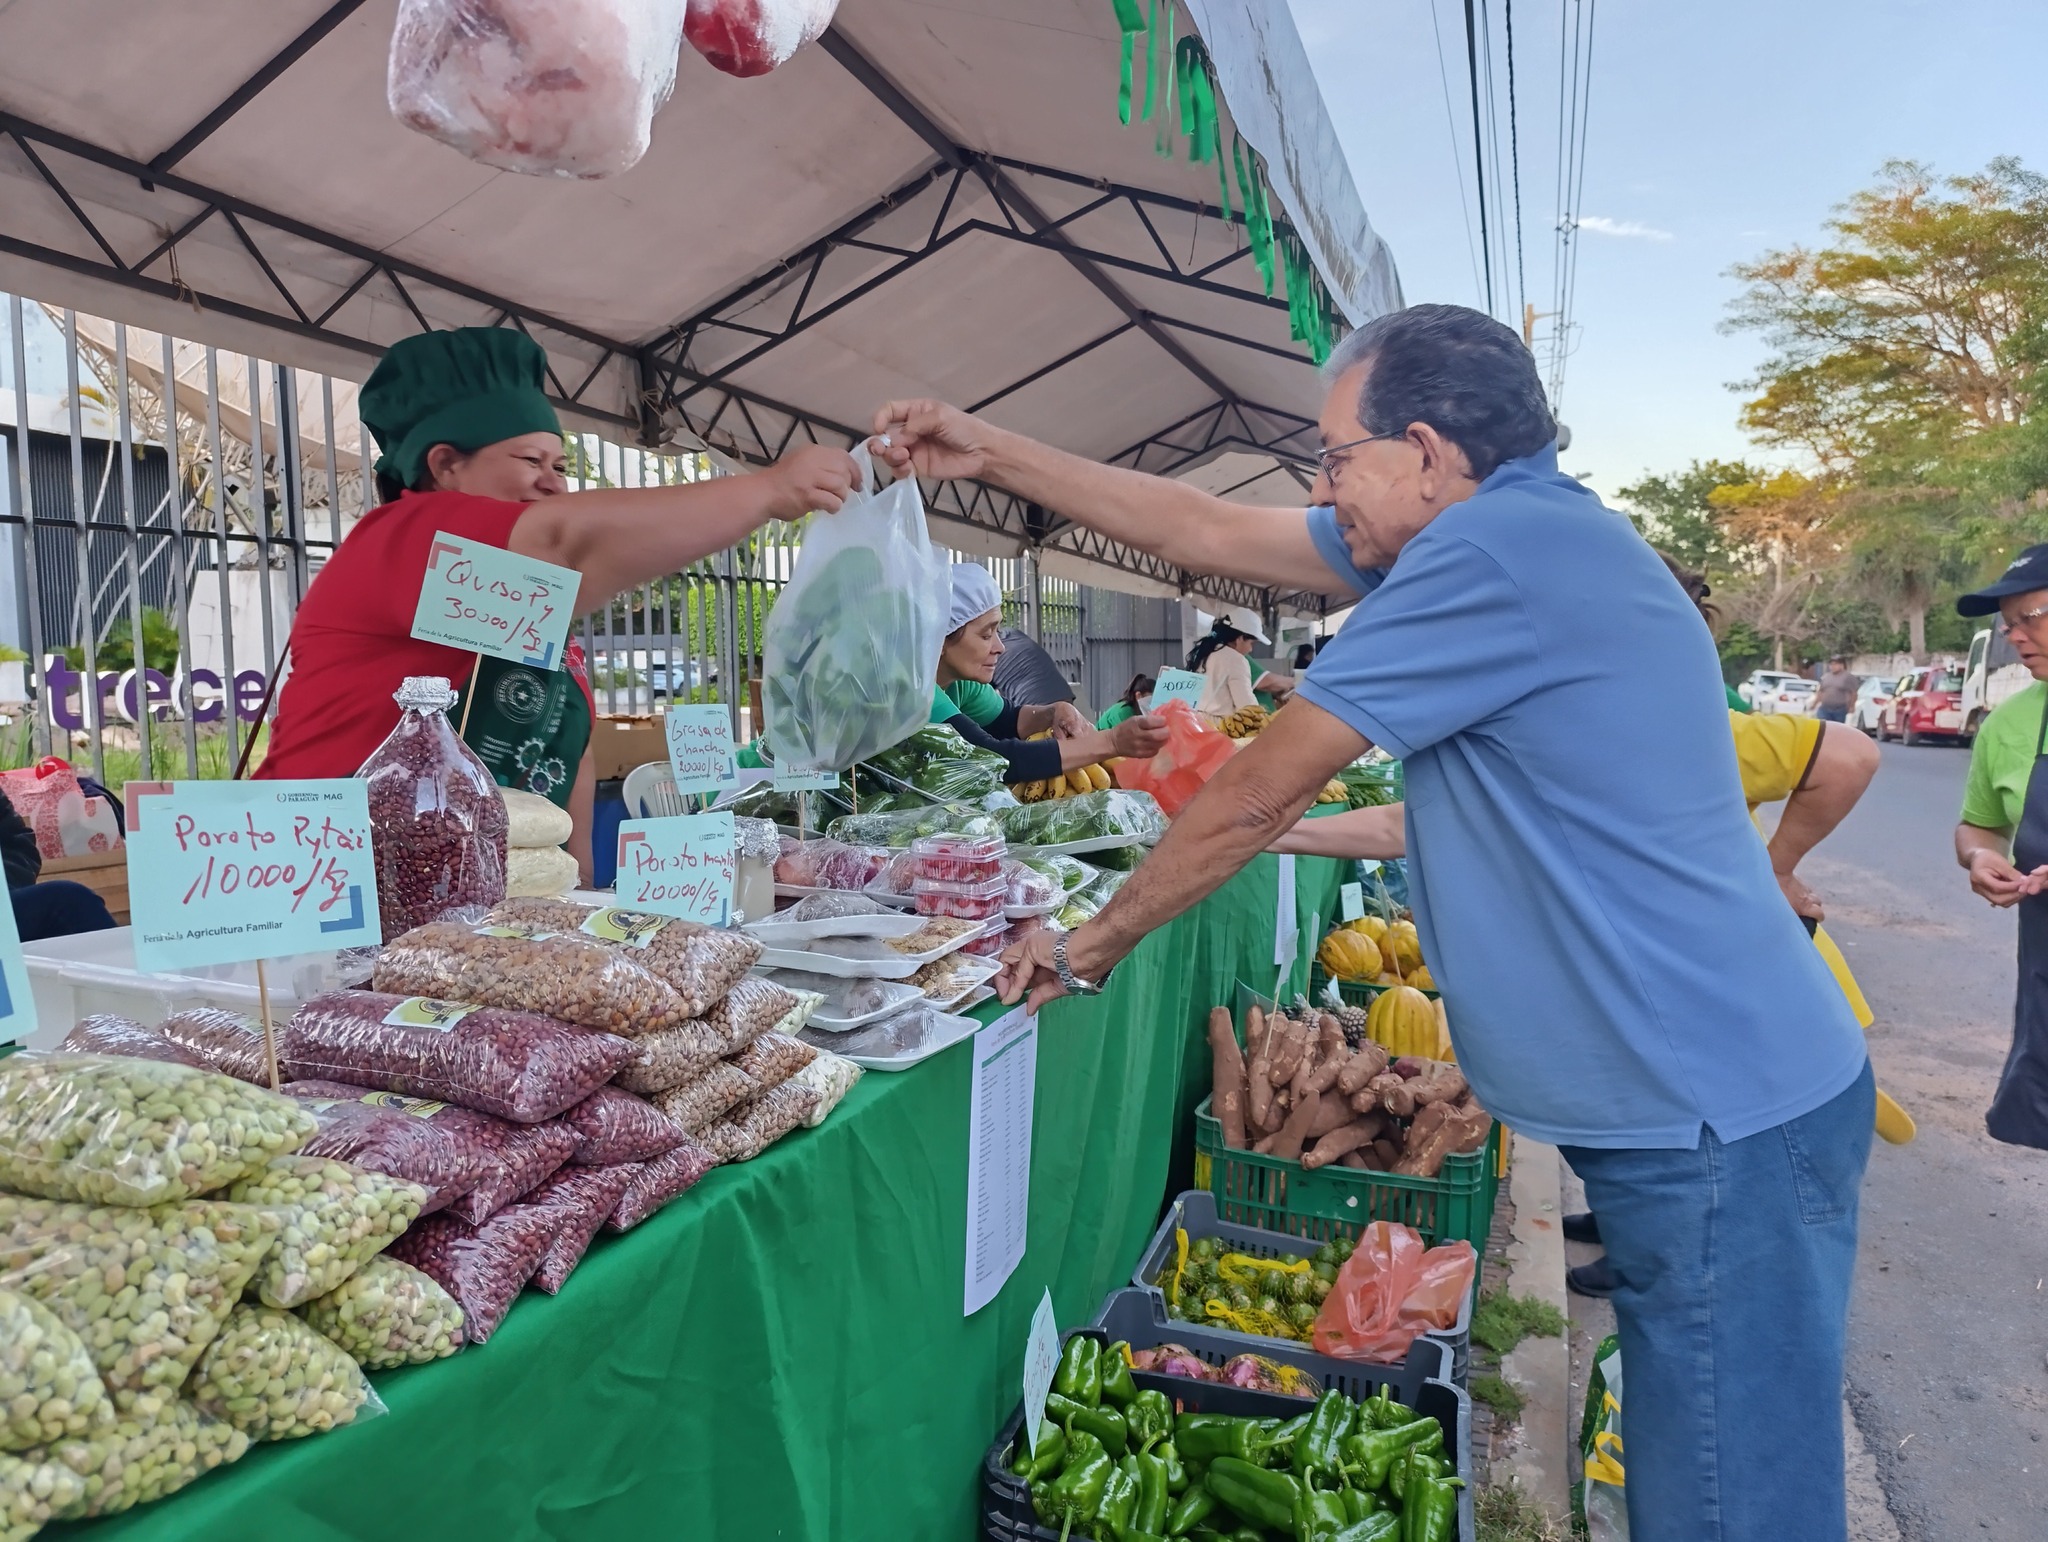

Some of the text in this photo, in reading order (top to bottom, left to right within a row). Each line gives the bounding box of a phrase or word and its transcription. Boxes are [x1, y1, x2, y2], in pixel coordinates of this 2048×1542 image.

[443, 633, 478, 647] Agricultura
[479, 641, 502, 652] Familiar
[44, 654, 268, 730] trece
[714, 719, 728, 739] de
[186, 926, 243, 940] Agricultura
[246, 921, 284, 932] Familiar
